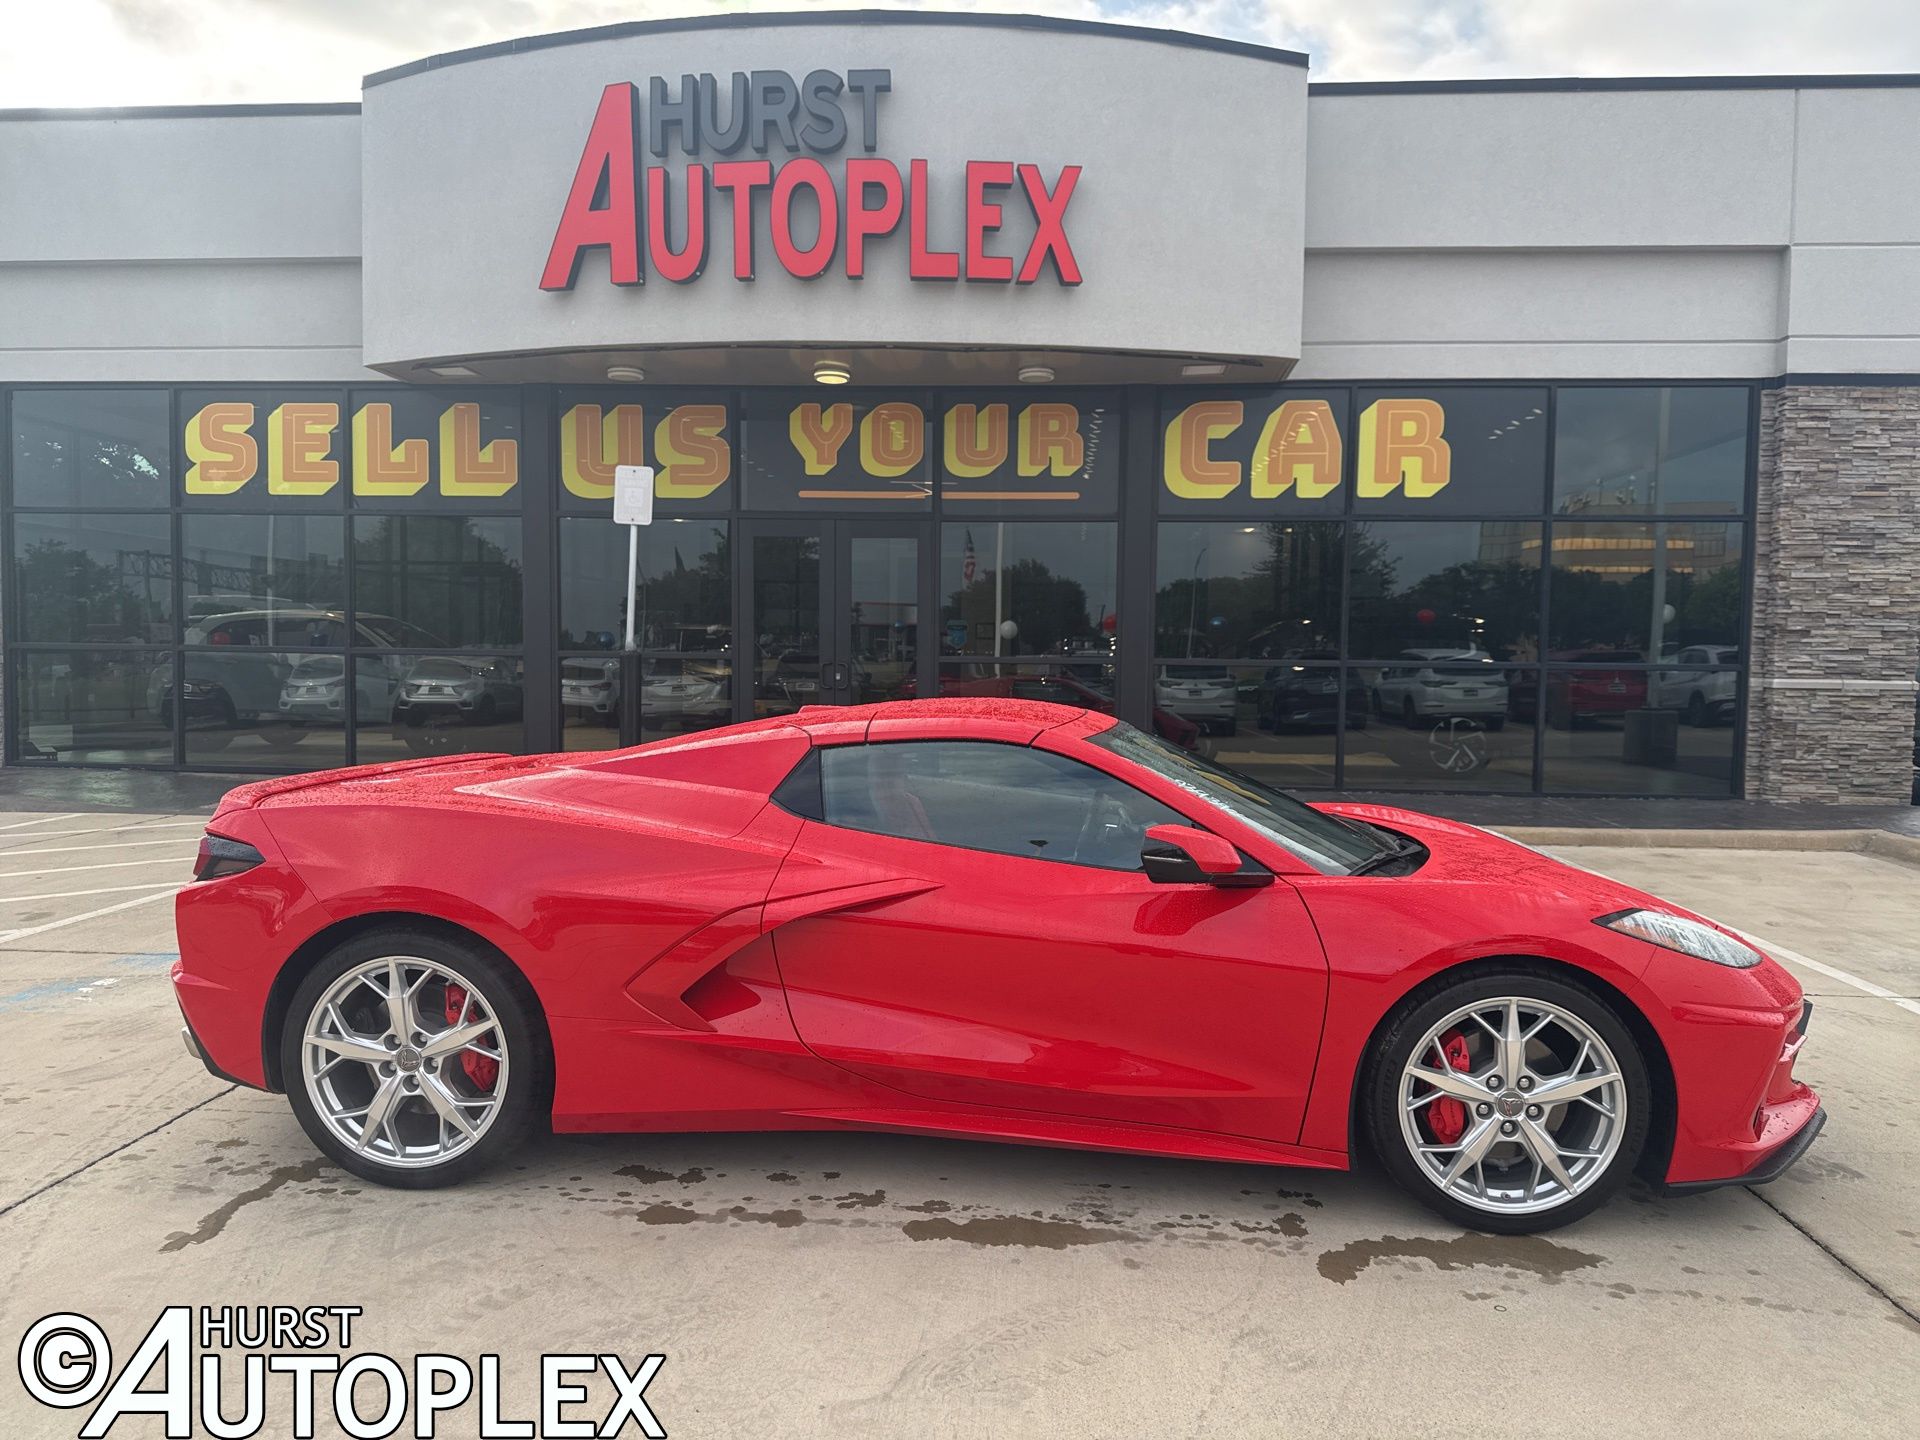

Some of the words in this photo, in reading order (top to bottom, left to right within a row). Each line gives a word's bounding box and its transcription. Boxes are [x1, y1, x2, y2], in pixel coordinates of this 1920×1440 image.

[649, 69, 892, 157] HURST
[539, 81, 1083, 291] AUTOPLEX
[185, 402, 518, 496] SELL
[561, 404, 731, 499] US
[789, 402, 1084, 478] YOUR
[1164, 398, 1451, 499] CAR
